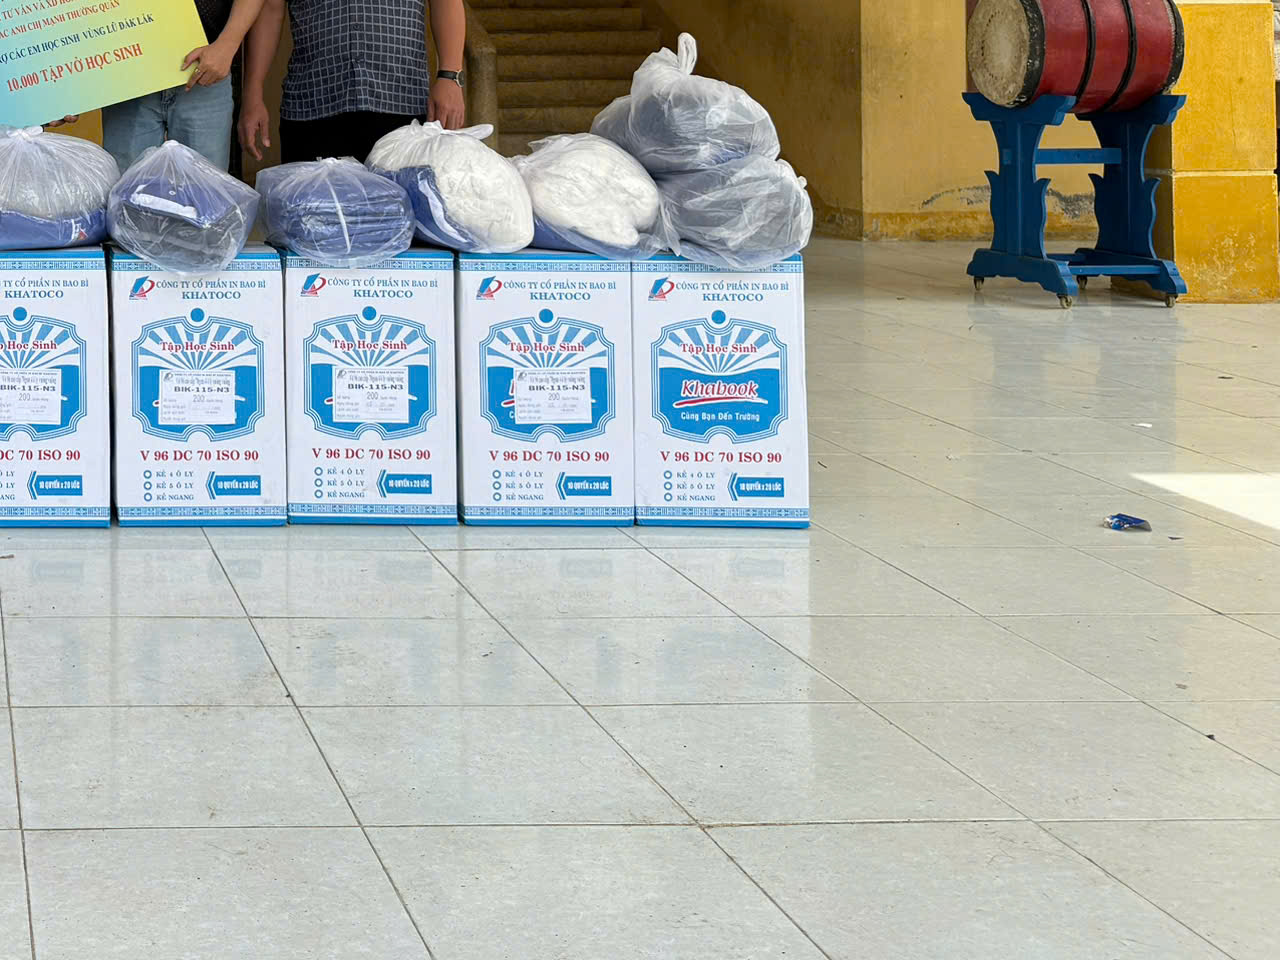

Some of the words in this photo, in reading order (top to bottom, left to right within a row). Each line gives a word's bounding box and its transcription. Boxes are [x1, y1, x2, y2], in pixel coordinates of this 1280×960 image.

[1, 7, 13, 19] TƯ
[11, 24, 26, 35] ANH
[27, 19, 42, 30] CHỊ
[41, 13, 65, 27] MẠNH
[8, 47, 26, 60] CÁC
[26, 44, 41, 55] EM
[41, 38, 59, 51] HỌC
[59, 33, 80, 46] SINH
[81, 26, 106, 39] VÙNG
[6, 71, 39, 91] 10.000
[39, 64, 63, 83] TẬP
[84, 51, 112, 69] HỌC
[112, 43, 143, 61] SINH
[781, 282, 789, 290] BÌ
[5, 291, 64, 299] KHATOCO
[182, 291, 241, 300] KHATOCO
[353, 290, 413, 299] KHATOCO
[530, 292, 591, 301] KHATOCO
[703, 293, 764, 302] KHATOCO
[7, 340, 29, 351] Học
[32, 340, 57, 349] Sinh
[161, 342, 182, 353] Tập
[185, 342, 207, 353] Học
[209, 342, 235, 351] Sinh
[332, 340, 354, 351] Tập
[358, 340, 379, 351] Học
[382, 340, 407, 349] Sinh
[509, 342, 531, 354] Tập
[534, 342, 556, 354] Học
[559, 342, 585, 352] Sinh
[681, 343, 704, 354] Tập
[706, 343, 728, 354] Học
[731, 343, 757, 352] Sinh
[681, 380, 758, 396] Khabook
[681, 412, 699, 421] Cùng
[702, 413, 715, 421] Bạn
[660, 451, 671, 463] V
[674, 451, 689, 463] 96
[693, 451, 714, 463] DC
[719, 451, 734, 463] 70
[737, 451, 762, 463] ISO
[767, 451, 782, 463] 90
